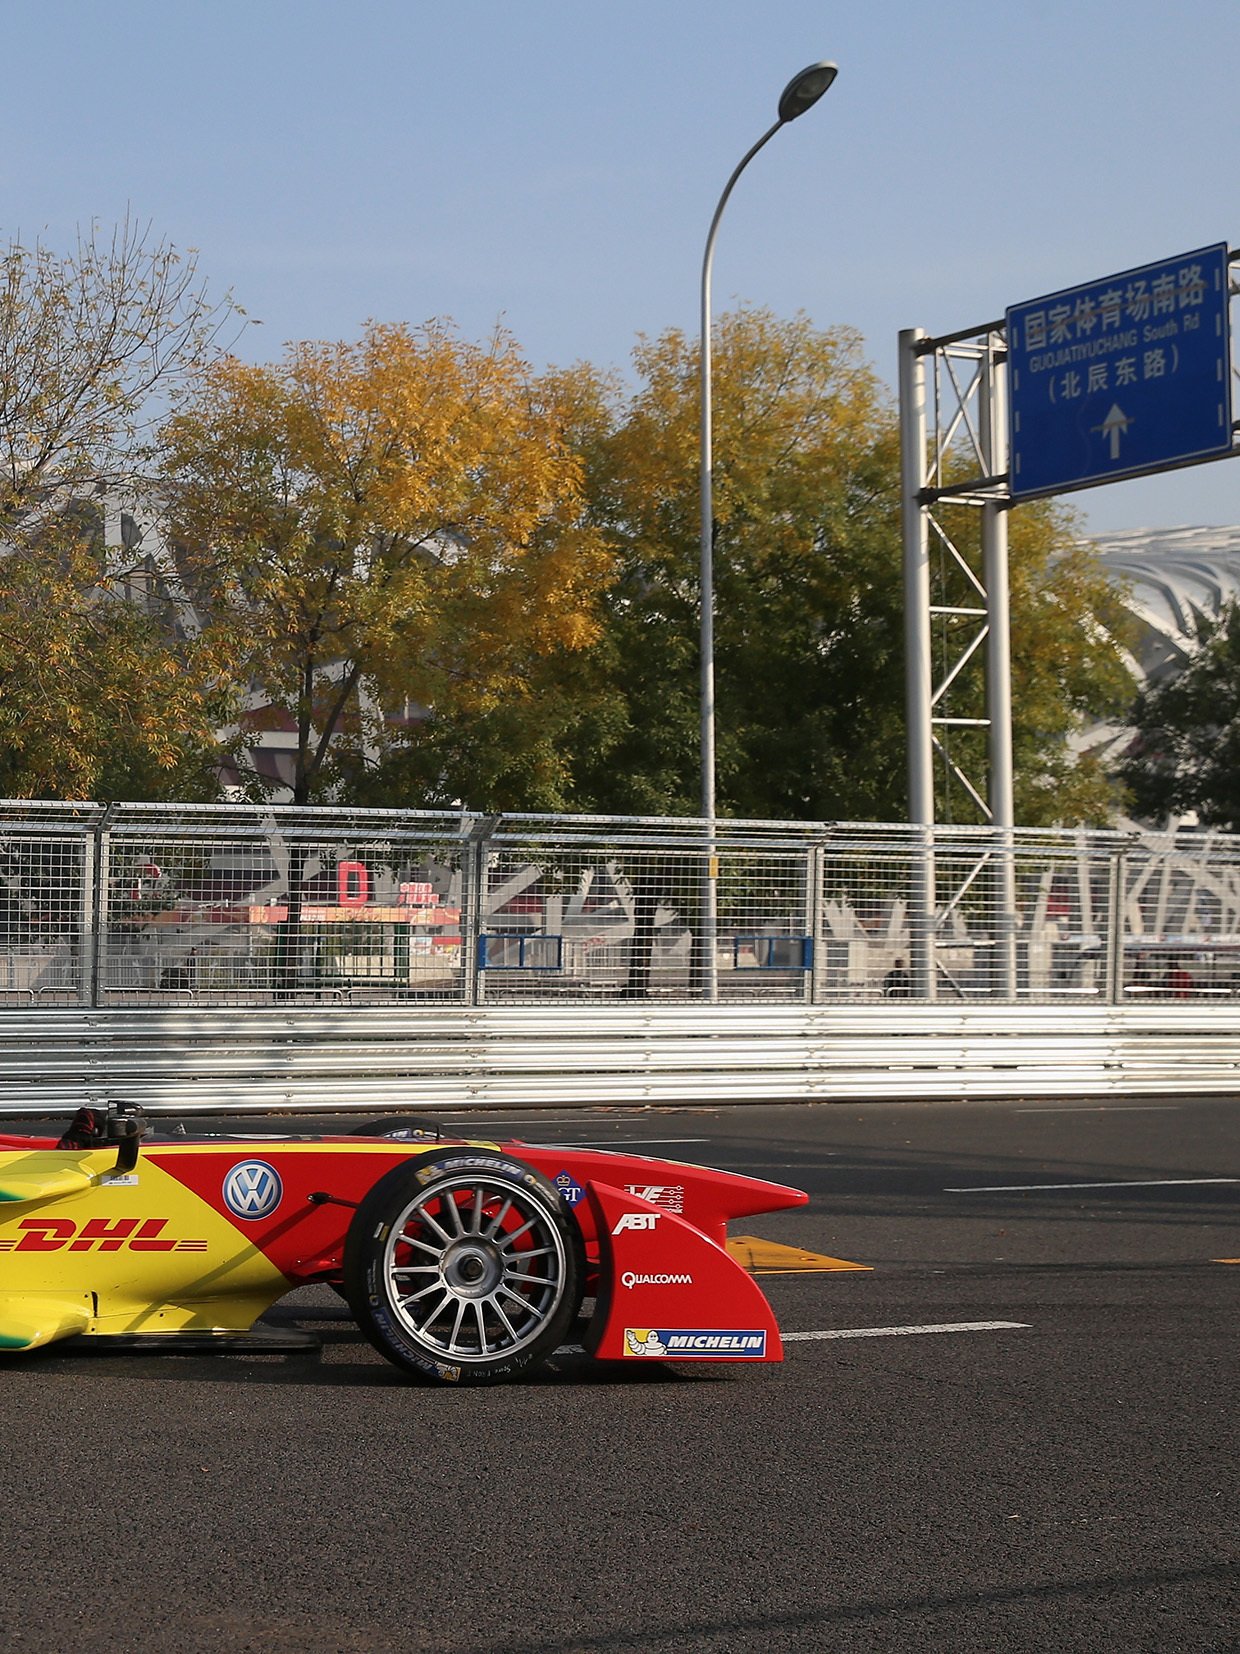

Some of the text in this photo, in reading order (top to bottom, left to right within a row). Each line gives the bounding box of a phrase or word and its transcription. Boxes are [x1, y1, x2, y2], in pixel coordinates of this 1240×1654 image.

[1024, 264, 1204, 350] 国家体育场南路
[1029, 312, 1200, 373] GUOJIATIYUCHANG South Rd
[444, 1158, 521, 1175] MICHELIN
[13, 1218, 178, 1251] DHL
[611, 1213, 661, 1235] ABT
[621, 1271, 692, 1289] QUALCOMM
[375, 1313, 432, 1370] MICHELIN
[667, 1335, 763, 1348] MICHELIN
